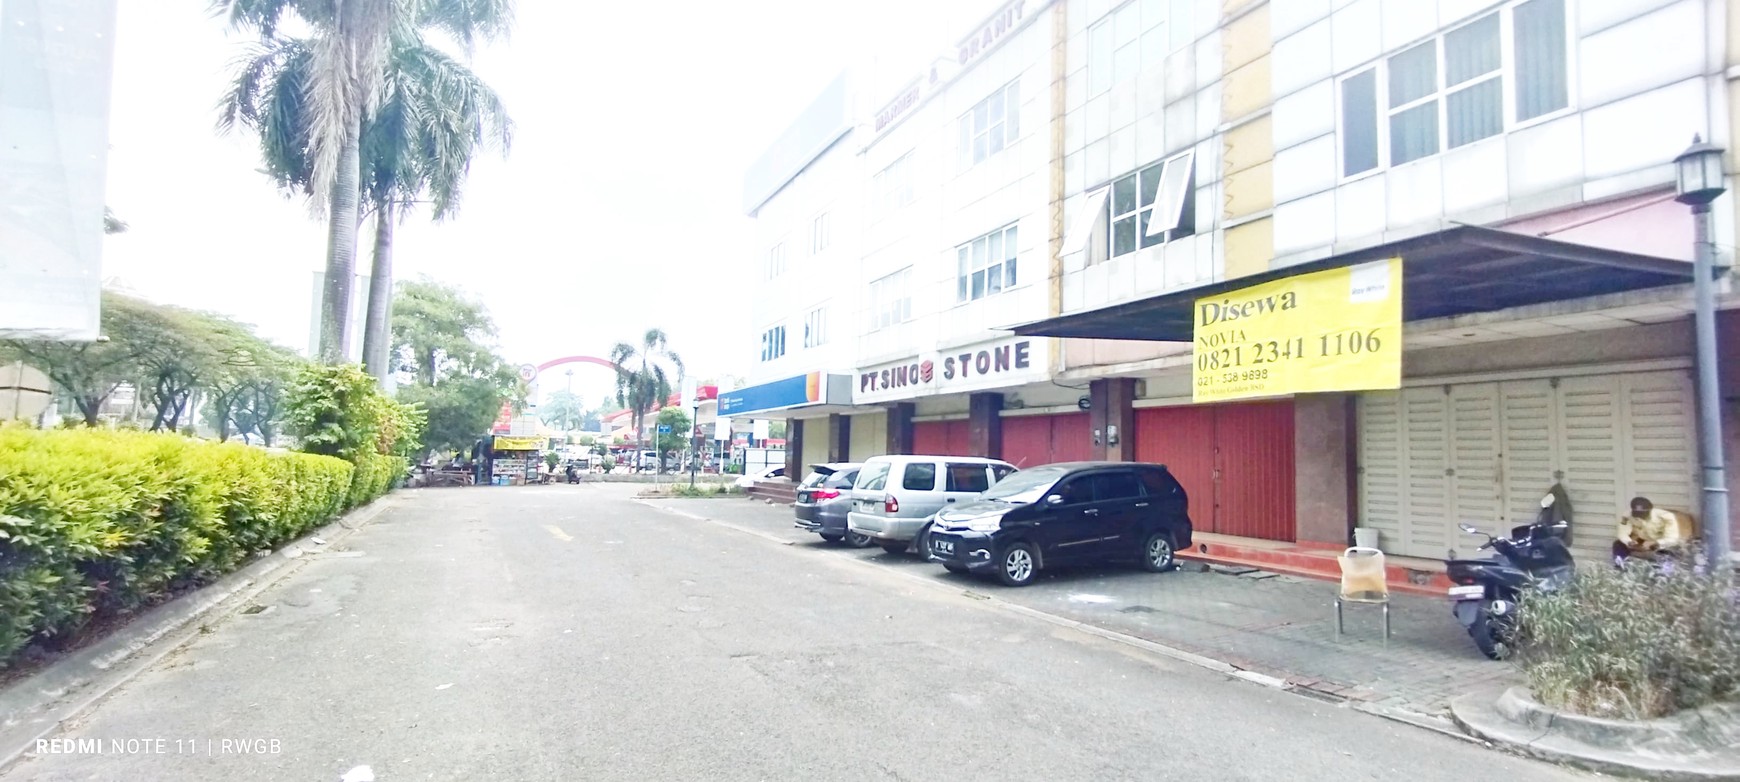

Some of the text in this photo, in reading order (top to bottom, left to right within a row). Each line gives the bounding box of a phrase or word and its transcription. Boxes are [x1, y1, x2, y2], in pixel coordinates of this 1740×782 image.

[1200, 291, 1297, 327] Disewa
[1198, 328, 1381, 371] 0821 2341 1106
[1199, 330, 1247, 350] NOVIA
[944, 341, 1030, 380] STONE
[1197, 376, 1213, 387] 021
